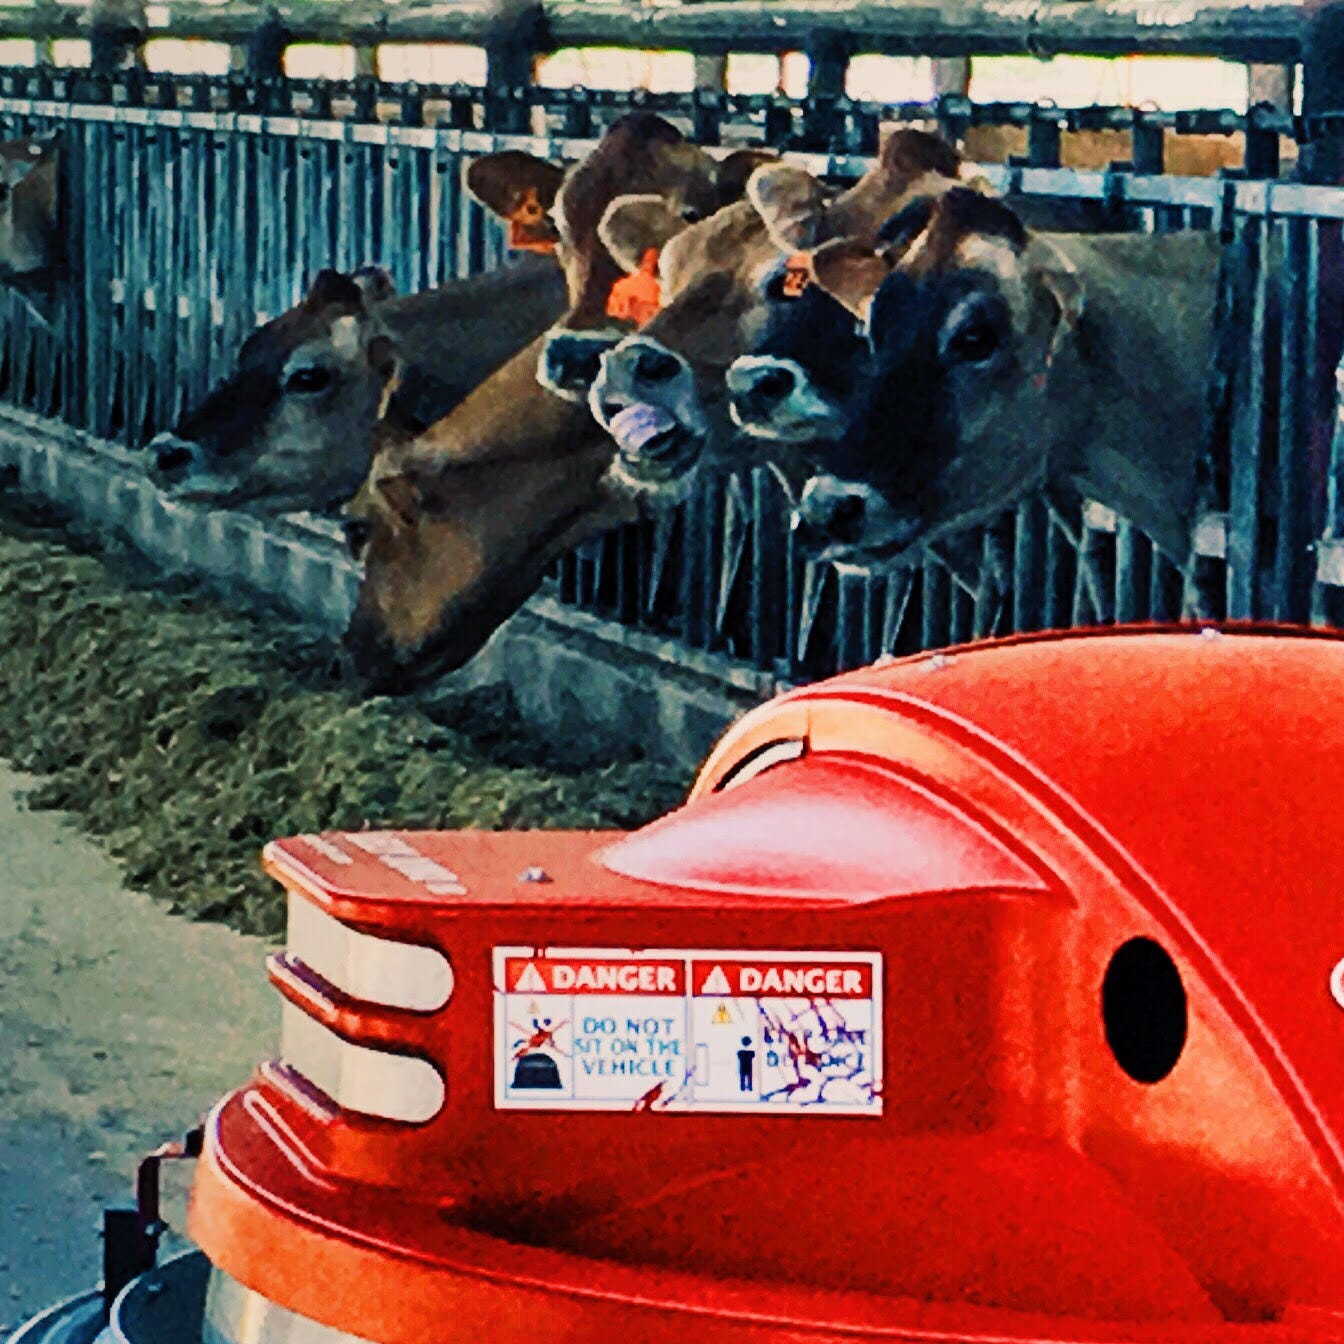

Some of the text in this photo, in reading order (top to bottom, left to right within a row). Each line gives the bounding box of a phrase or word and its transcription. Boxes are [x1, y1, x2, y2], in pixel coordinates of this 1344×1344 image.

[552, 964, 677, 992] DANGER
[739, 966, 863, 995] DANGER
[583, 1016, 675, 1035] DO NOT
[575, 1037, 681, 1056] SIT ON THE
[582, 1058, 677, 1077] VEHICLE
